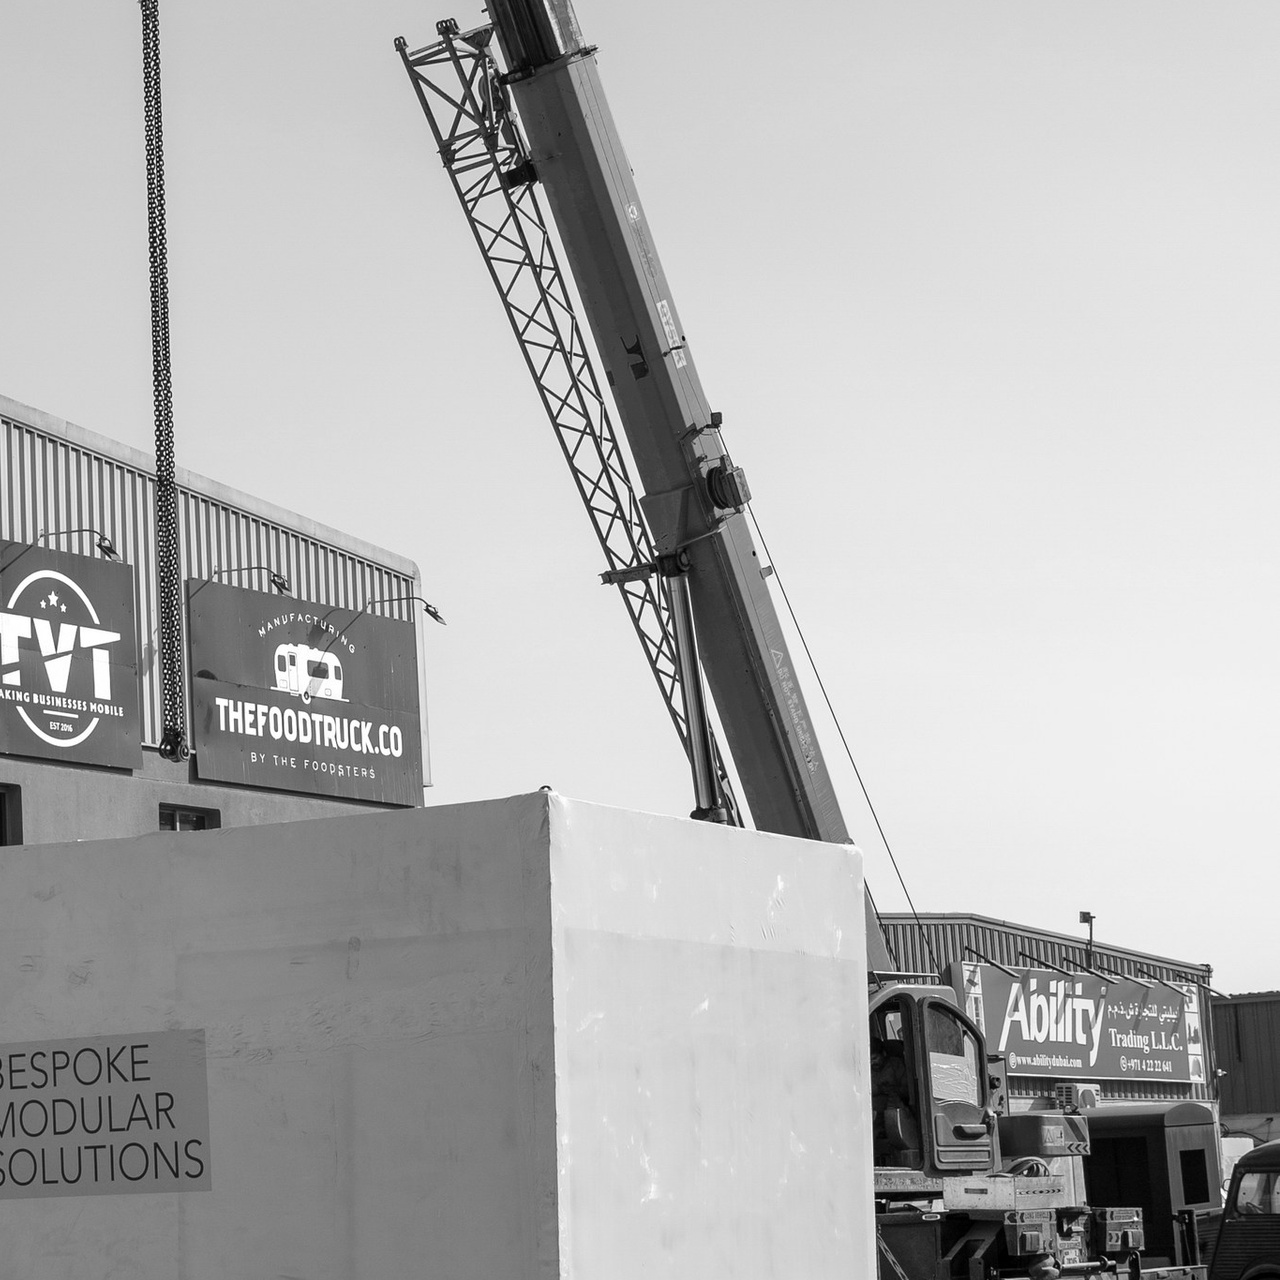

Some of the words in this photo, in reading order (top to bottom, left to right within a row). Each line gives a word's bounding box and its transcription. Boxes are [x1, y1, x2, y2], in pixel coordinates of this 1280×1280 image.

[258, 612, 356, 654] MANUFACTURING
[32, 693, 87, 712] BUSINESSES
[89, 702, 124, 717] MOBILE
[49, 721, 60, 731] EST
[60, 722, 74, 733] 2016
[215, 697, 403, 758] THEFOODTRUCK.CO
[250, 751, 266, 763] BY
[273, 754, 297, 768] THE
[998, 978, 1106, 1067] Ability
[1108, 1028, 1150, 1054] Trading
[1150, 1030, 1183, 1051] L.L.C.
[1016, 1053, 1083, 1070] www.abilitydubai.com
[1127, 1058, 1141, 1071] +971
[1146, 1059, 1154, 1072] 22
[1154, 1060, 1162, 1072] 22
